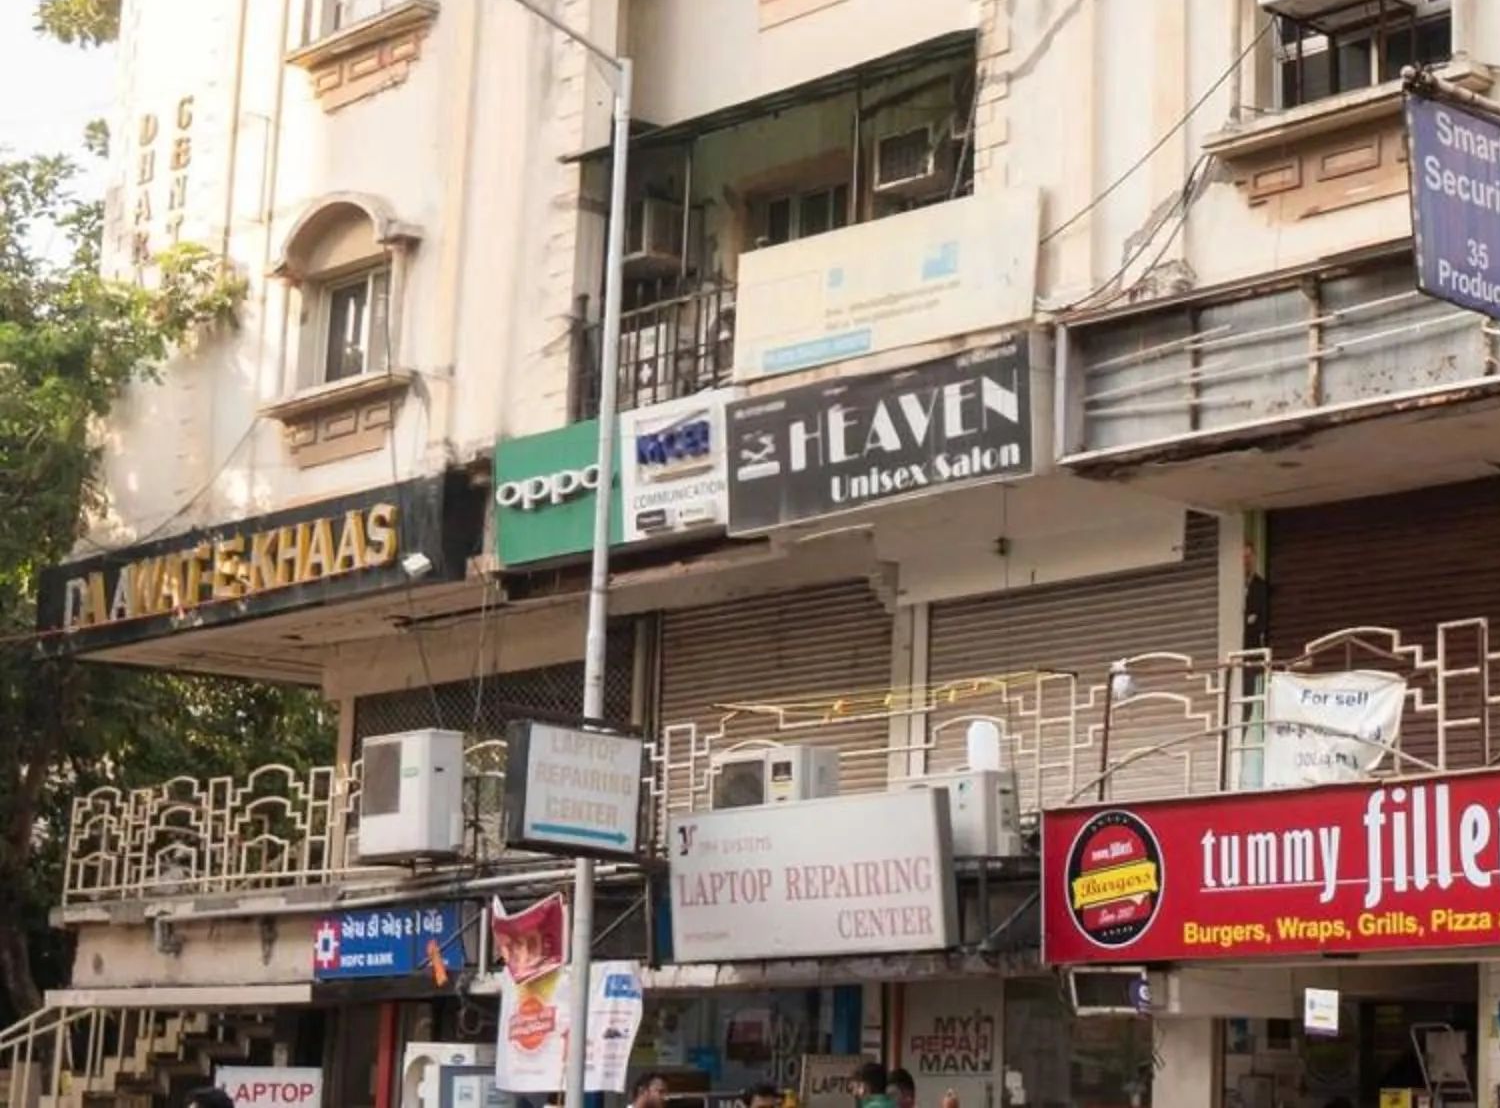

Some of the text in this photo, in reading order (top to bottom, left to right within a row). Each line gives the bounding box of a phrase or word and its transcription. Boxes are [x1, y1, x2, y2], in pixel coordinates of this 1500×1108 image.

[789, 368, 1019, 472] HEAVEN
[496, 463, 602, 509] oppo
[831, 442, 1020, 503] Unisex Salon
[1301, 689, 1330, 705] For
[534, 759, 632, 797] REPAIRING
[545, 794, 618, 828] CENTER
[679, 855, 932, 908] LAPTOP REPAIRING
[1201, 826, 1341, 903] tummy
[836, 905, 933, 939] CENTER
[1183, 922, 1271, 947] Burgers,
[1277, 917, 1351, 942] Wraps,
[1359, 911, 1424, 935] Grills,
[1431, 909, 1491, 931] Pizza
[366, 952, 393, 967] BANK
[933, 1015, 973, 1034] MY
[919, 1053, 979, 1074] MAN
[811, 1074, 857, 1096] LAPTO
